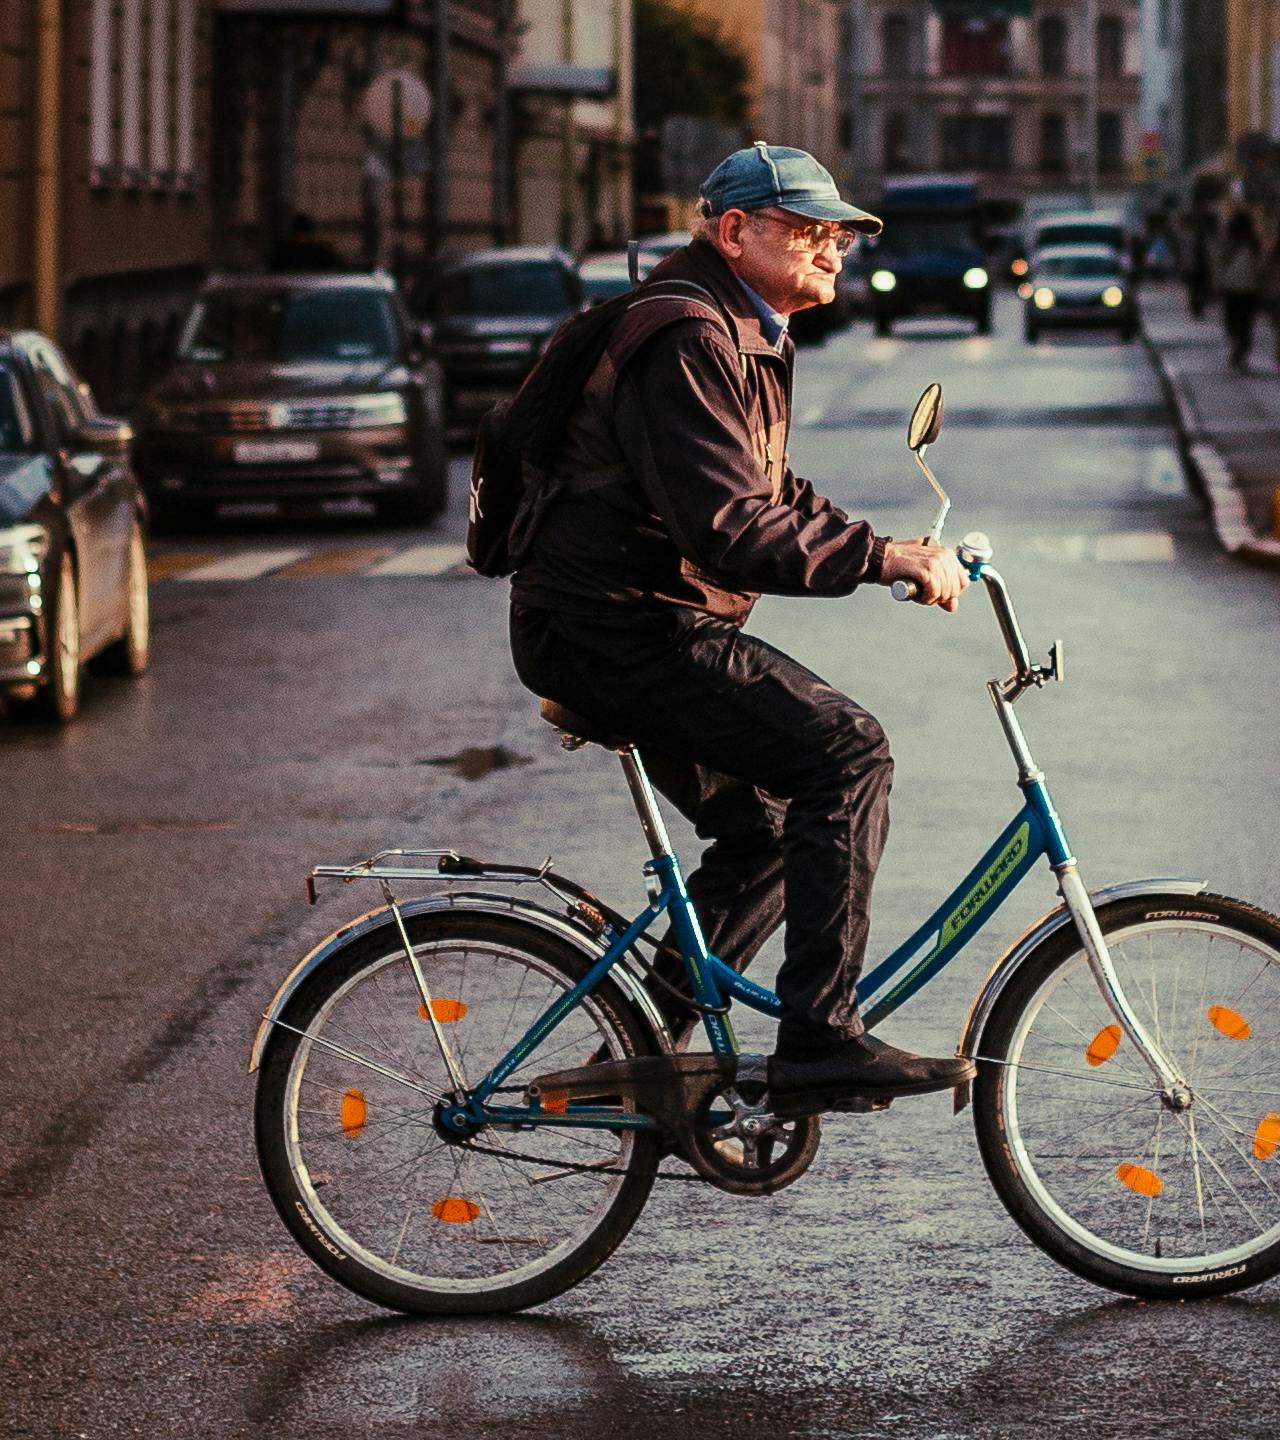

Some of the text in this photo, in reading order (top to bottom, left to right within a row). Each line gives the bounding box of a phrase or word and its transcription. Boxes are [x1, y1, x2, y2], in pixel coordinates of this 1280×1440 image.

[950, 837, 1023, 930] FORWARD
[1144, 909, 1220, 921] FORWARD
[294, 1201, 348, 1261] FORWARD
[1172, 1263, 1248, 1284] FORWARD
